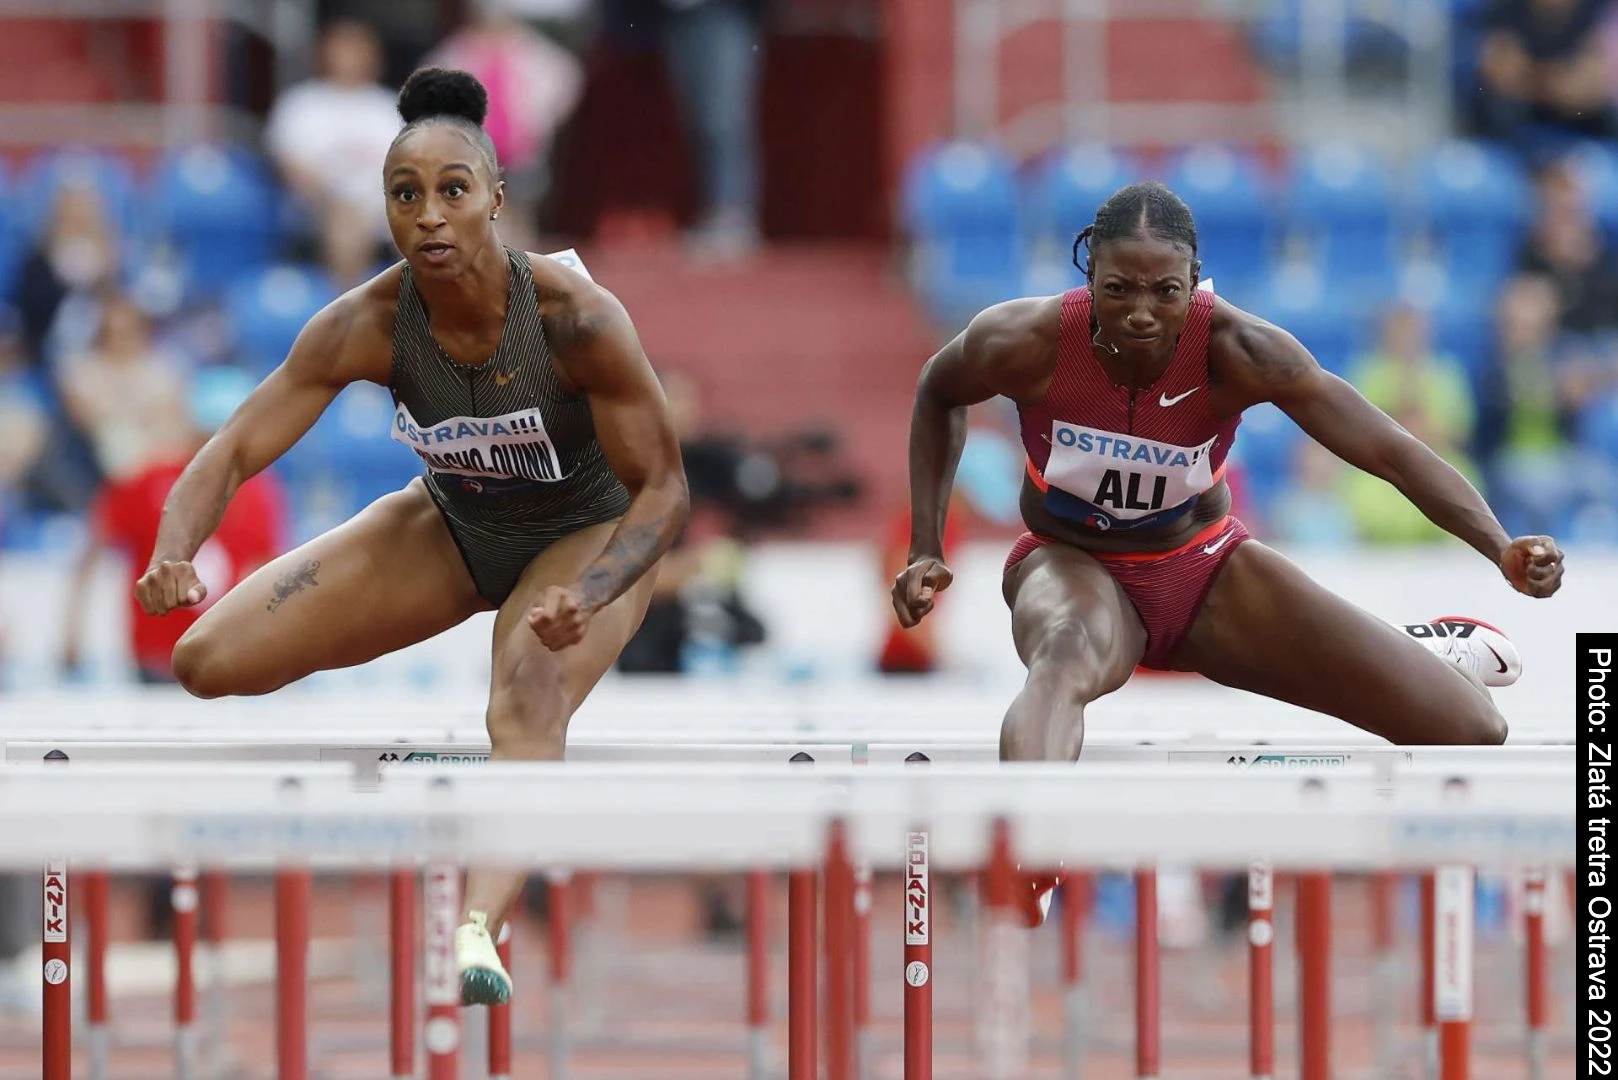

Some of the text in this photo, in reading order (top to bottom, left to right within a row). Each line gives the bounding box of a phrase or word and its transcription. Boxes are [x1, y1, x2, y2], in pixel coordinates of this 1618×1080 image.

[396, 412, 539, 446] OSTRAVA!!!
[1093, 469, 1167, 510] ALI
[907, 834, 926, 936] POLANIK
